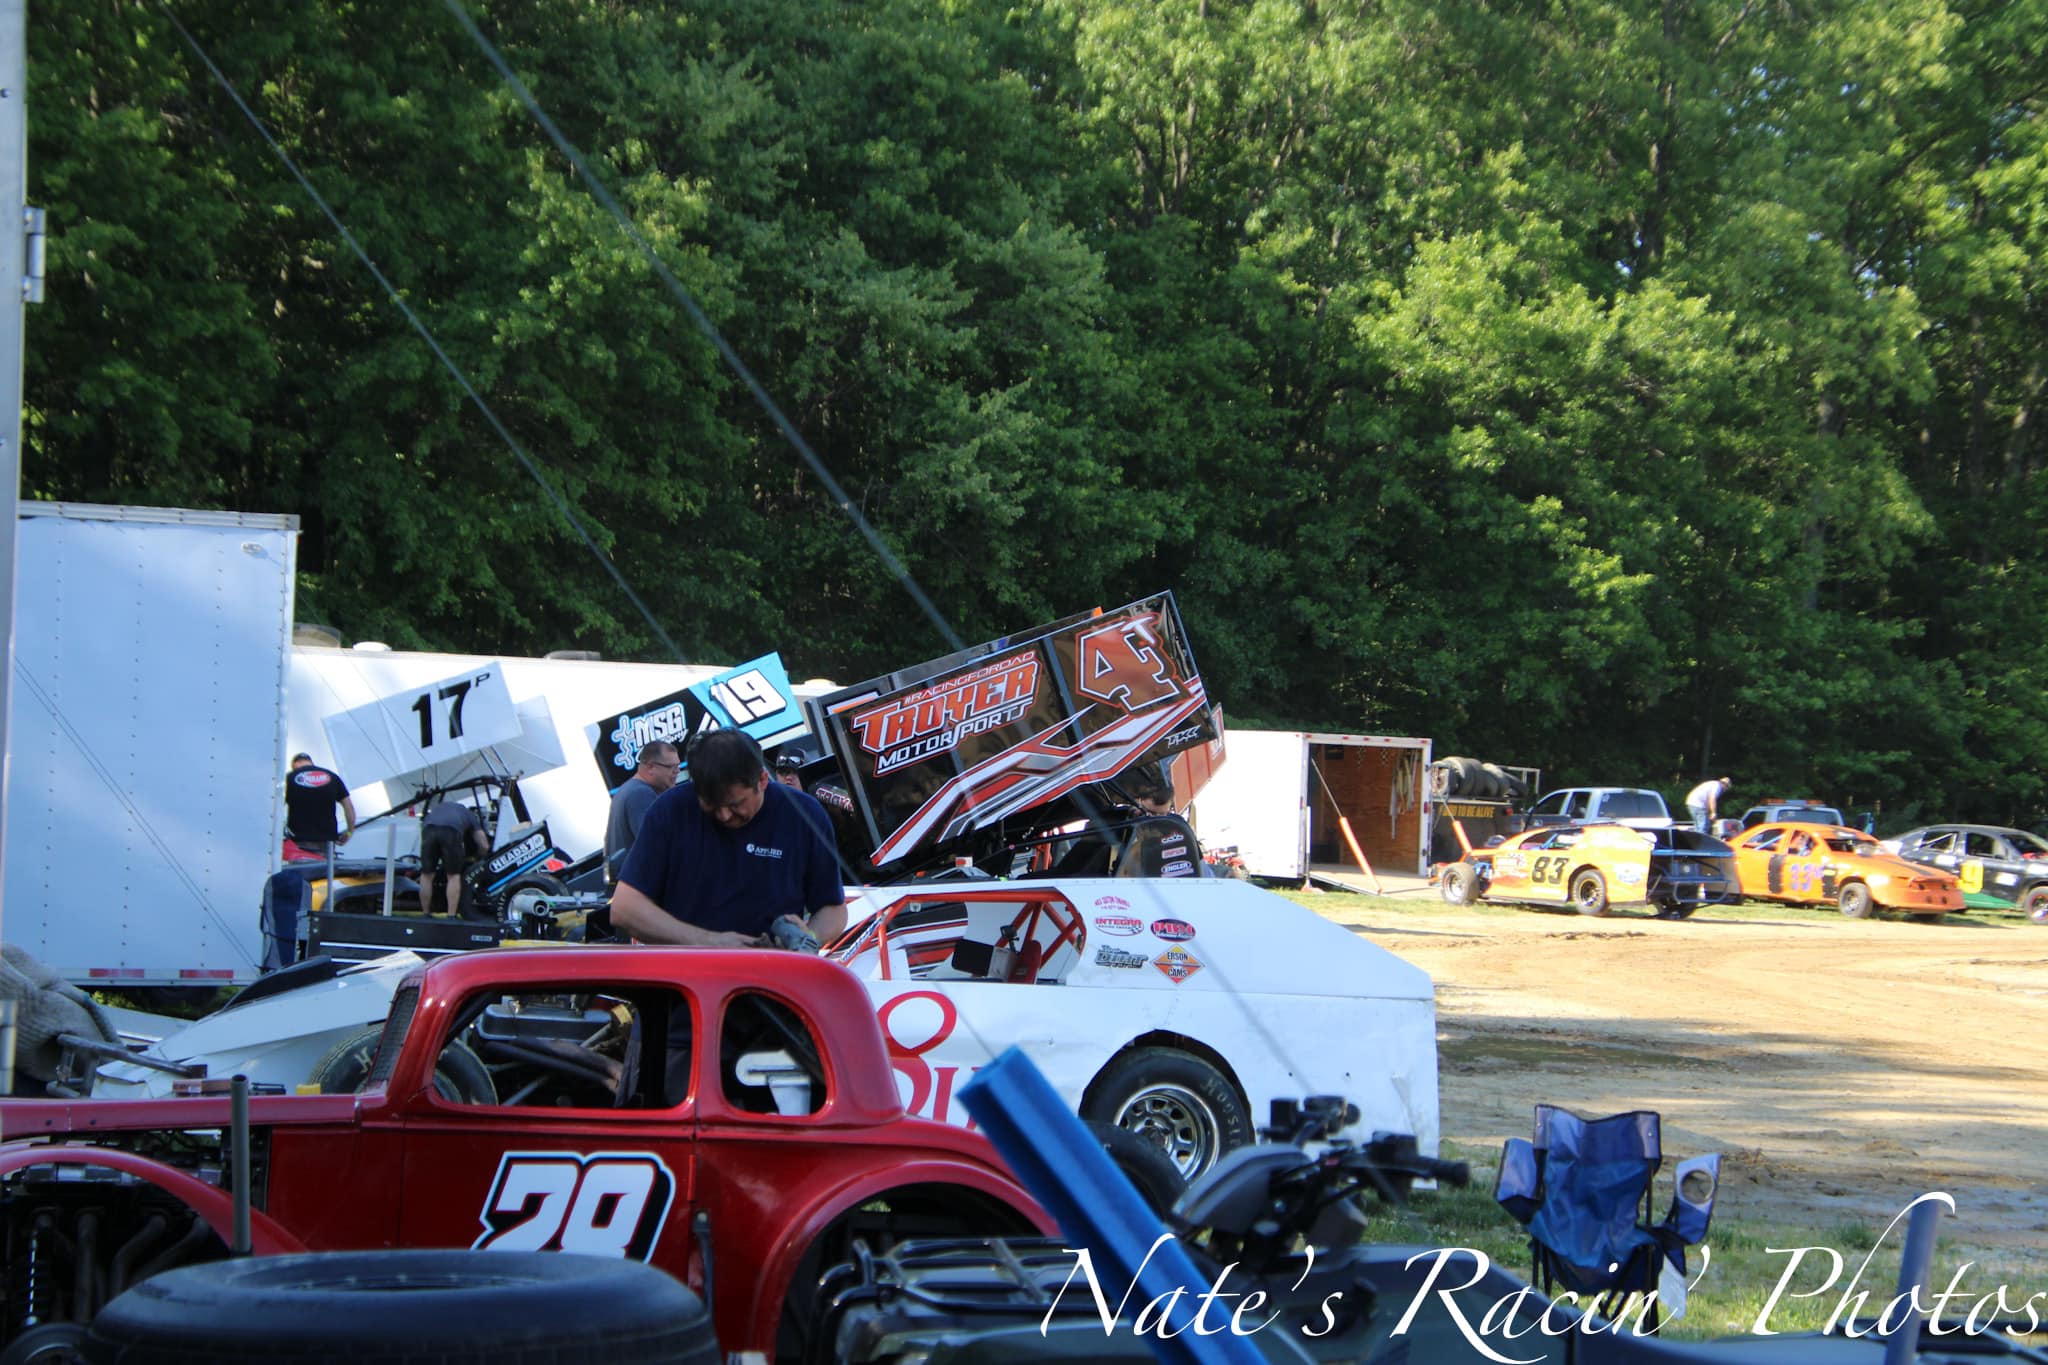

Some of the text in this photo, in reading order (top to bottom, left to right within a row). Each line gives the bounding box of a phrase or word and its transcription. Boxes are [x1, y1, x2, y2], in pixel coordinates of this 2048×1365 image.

[709, 668, 788, 727] 19
[853, 660, 1038, 753] TROYER
[632, 703, 685, 749] MSG
[877, 700, 1034, 774] MOTORSPORTS
[1531, 856, 1569, 884] 83
[1095, 917, 1142, 926] INTEGRA
[1167, 951, 1189, 961] ERSON
[1167, 968, 1188, 978] CAMS
